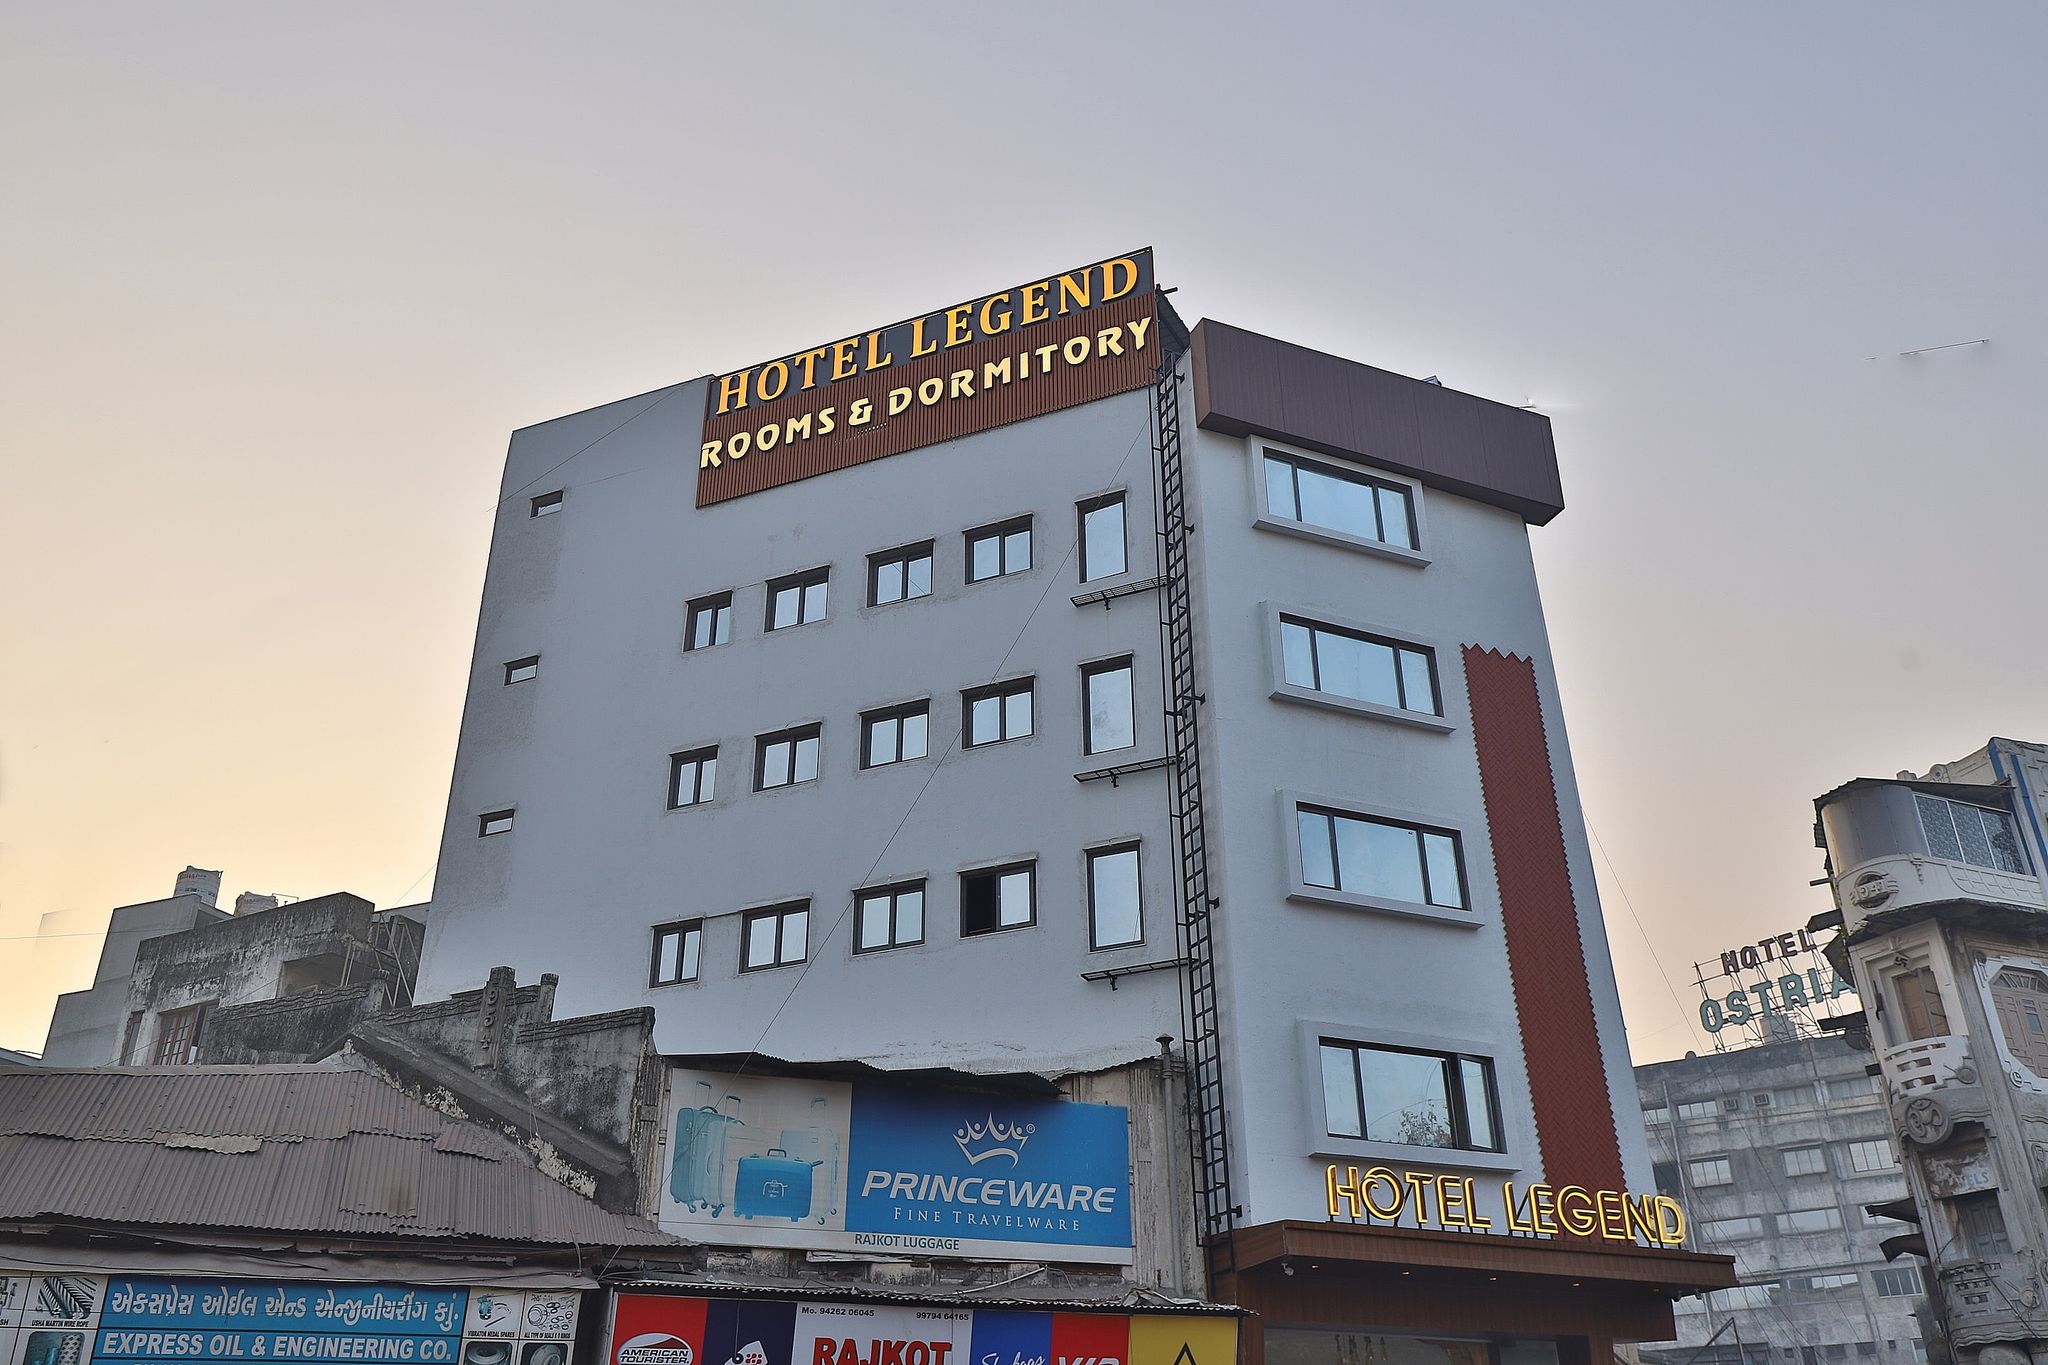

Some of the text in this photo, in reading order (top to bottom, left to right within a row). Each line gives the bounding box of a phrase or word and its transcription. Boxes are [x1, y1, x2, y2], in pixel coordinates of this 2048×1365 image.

[716, 258, 1139, 415] HOTEL LEGEND
[701, 316, 1152, 469] ROOMS & DORMITORY
[1720, 928, 1817, 976] HOTEL
[861, 1170, 1117, 1213] PRINCEWARE
[1325, 1164, 1688, 1245] HOTEL LEGEND
[894, 1207, 1080, 1231] FINE TRAVELWARE
[855, 1233, 960, 1250] RAJKOT LUGGAGE
[801, 1306, 875, 1317] Mo. 94262 06045
[916, 1311, 969, 1321] 99794 64165
[102, 1332, 452, 1360] EXPRESS OIL & ENGINEERING CO.
[620, 1349, 689, 1357] AMERICAN
[620, 1356, 690, 1364] TOURISTER.
[813, 1337, 952, 1365] RAJKOT
